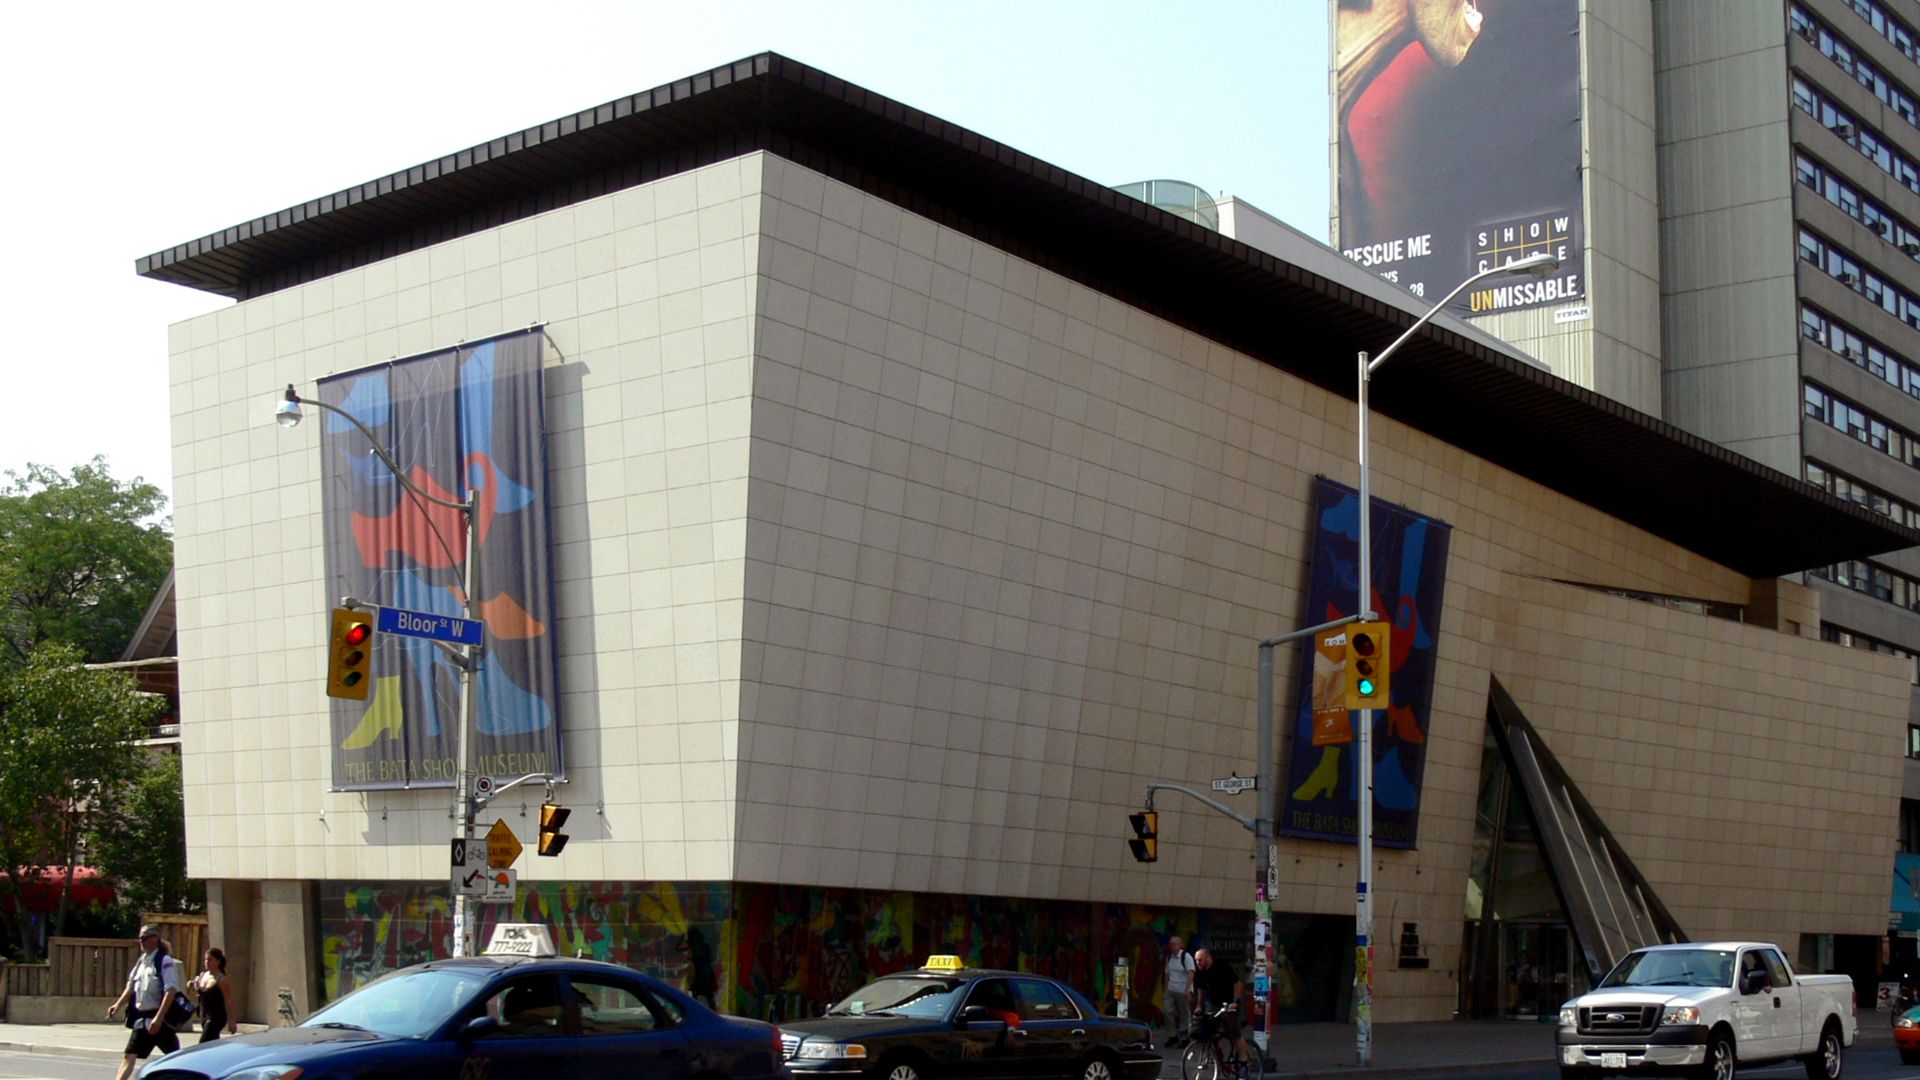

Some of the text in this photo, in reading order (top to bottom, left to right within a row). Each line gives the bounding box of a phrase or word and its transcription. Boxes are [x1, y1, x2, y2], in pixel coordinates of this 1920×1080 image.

[1407, 234, 1432, 258] ME
[1470, 275, 1577, 312] UNMISSABLE
[1556, 308, 1589, 319] TITAN
[398, 611, 464, 637] Bloor St W
[346, 761, 374, 782] THE
[380, 759, 418, 781] BATA
[1291, 811, 1311, 830] THE
[492, 940, 533, 953] 777-9222
[929, 957, 953, 967] TAXI
